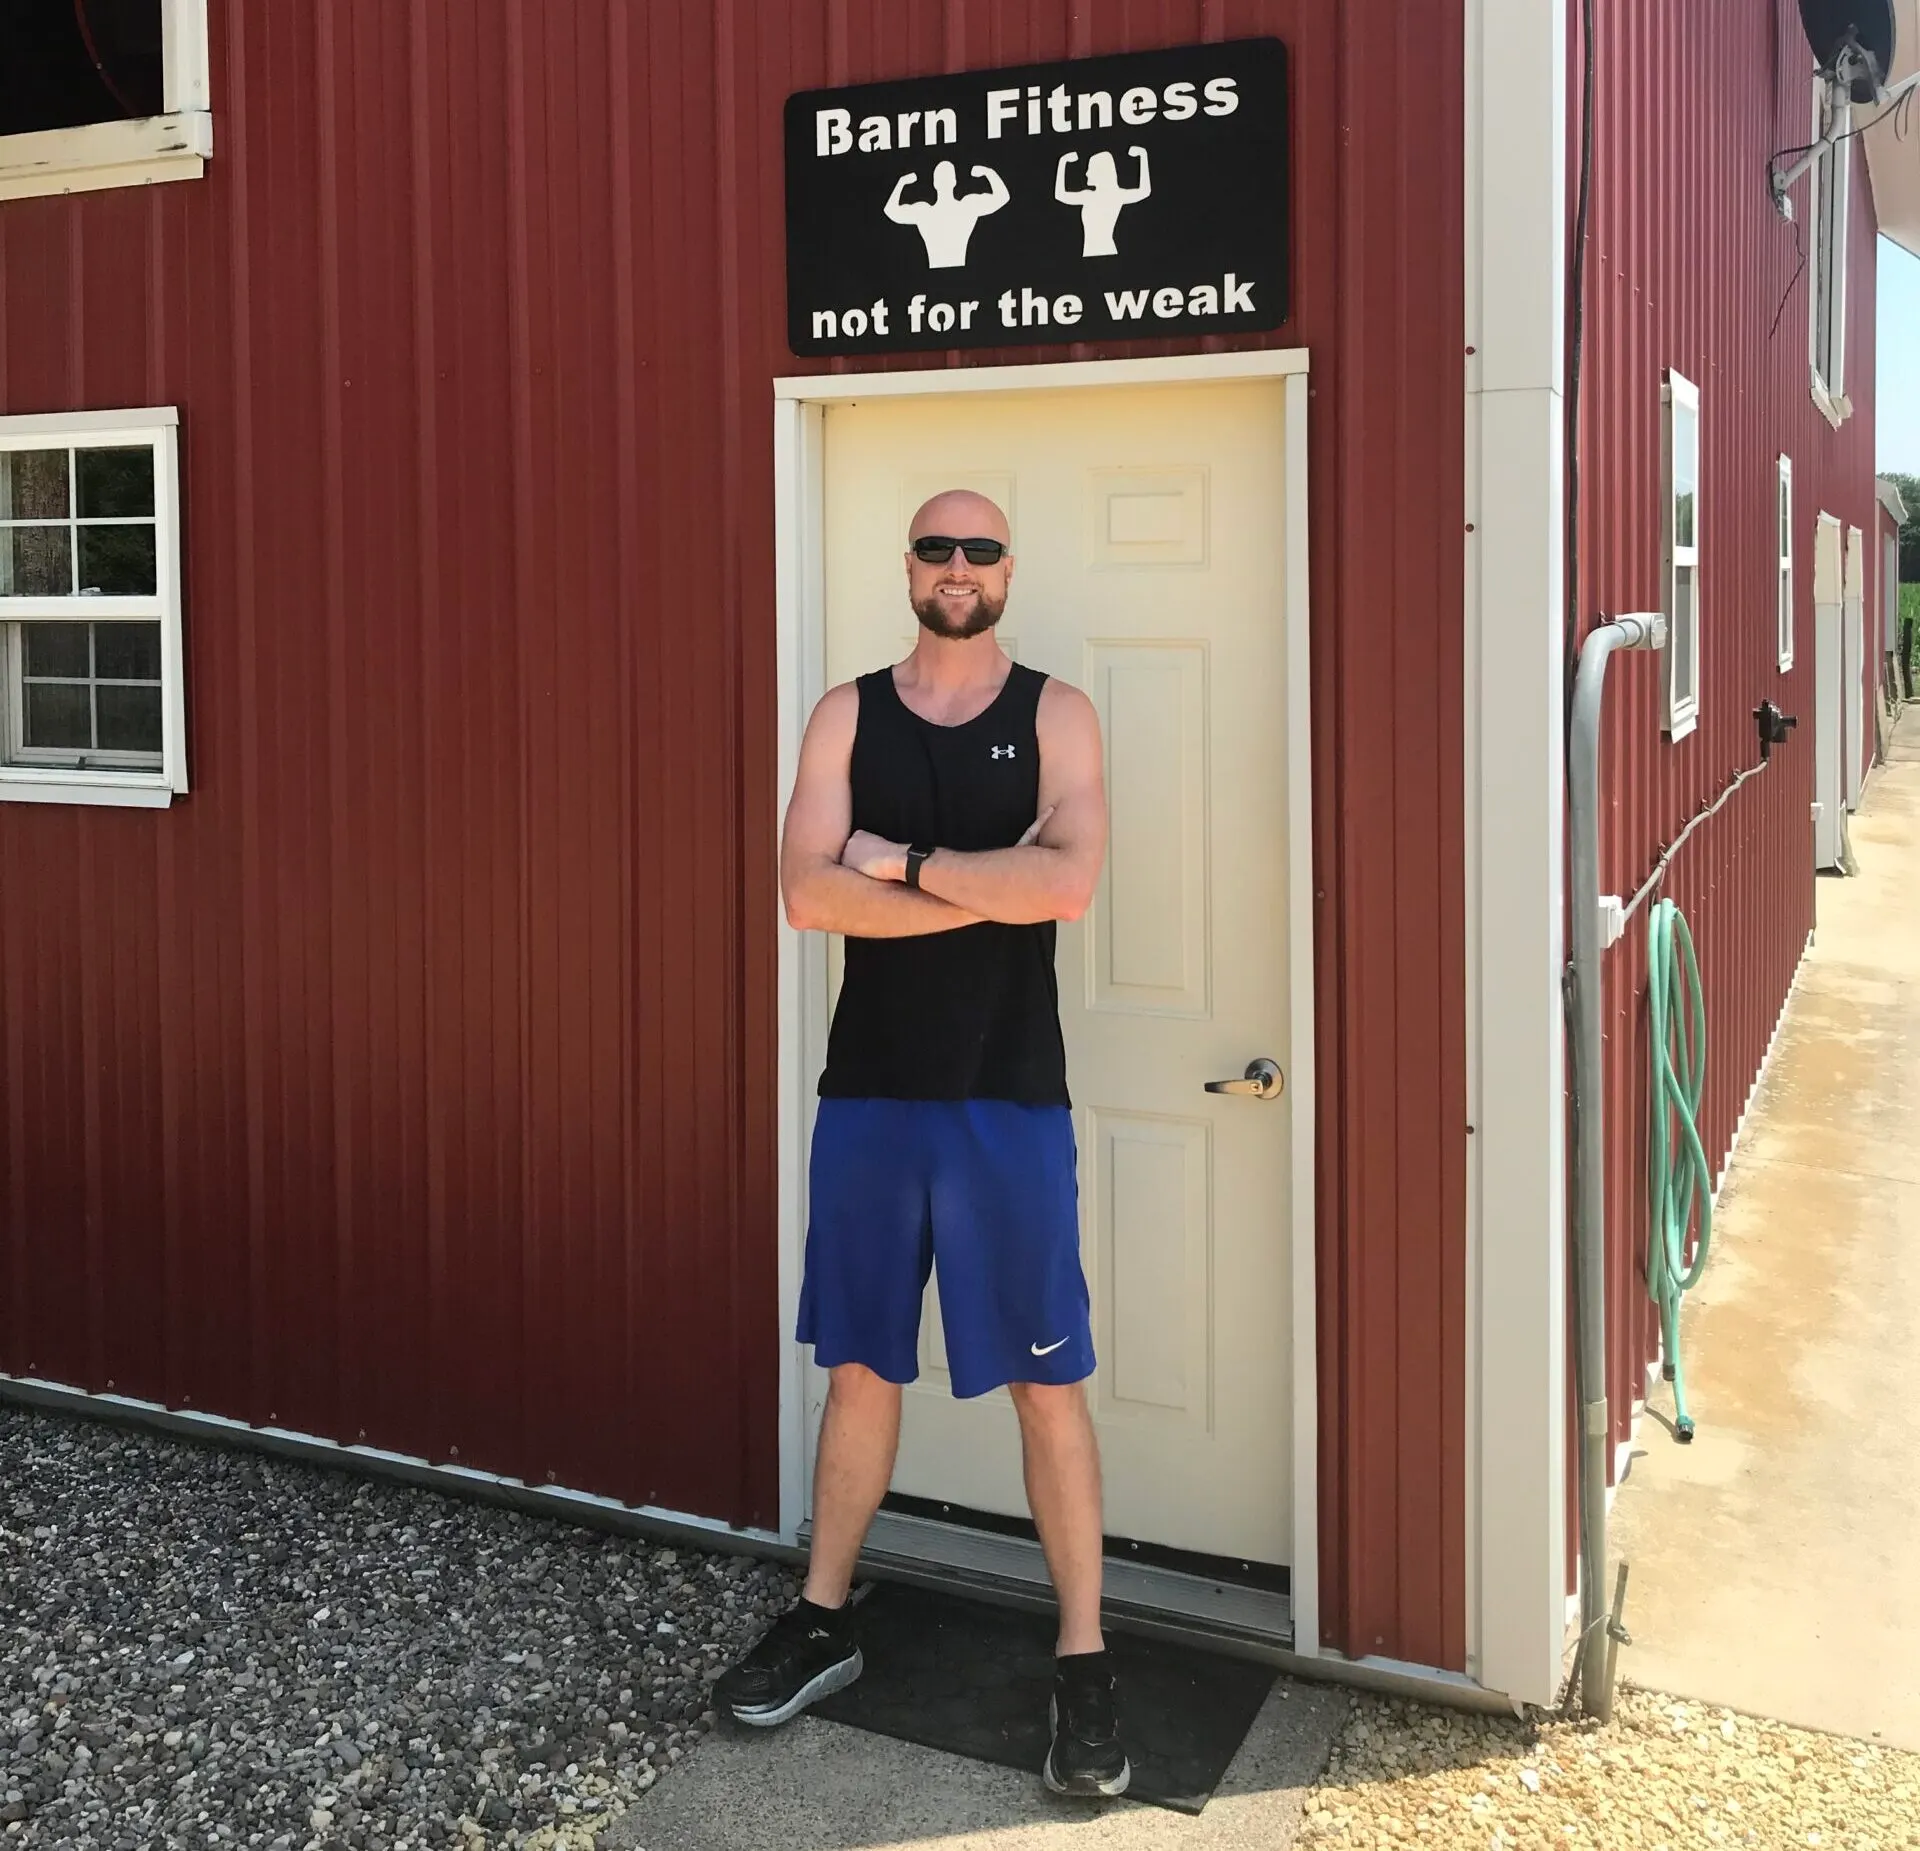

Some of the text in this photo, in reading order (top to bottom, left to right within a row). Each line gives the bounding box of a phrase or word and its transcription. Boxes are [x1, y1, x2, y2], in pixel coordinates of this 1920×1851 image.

[816, 77, 1239, 157] Barn Fitness
[812, 272, 1256, 339] not for the weak
